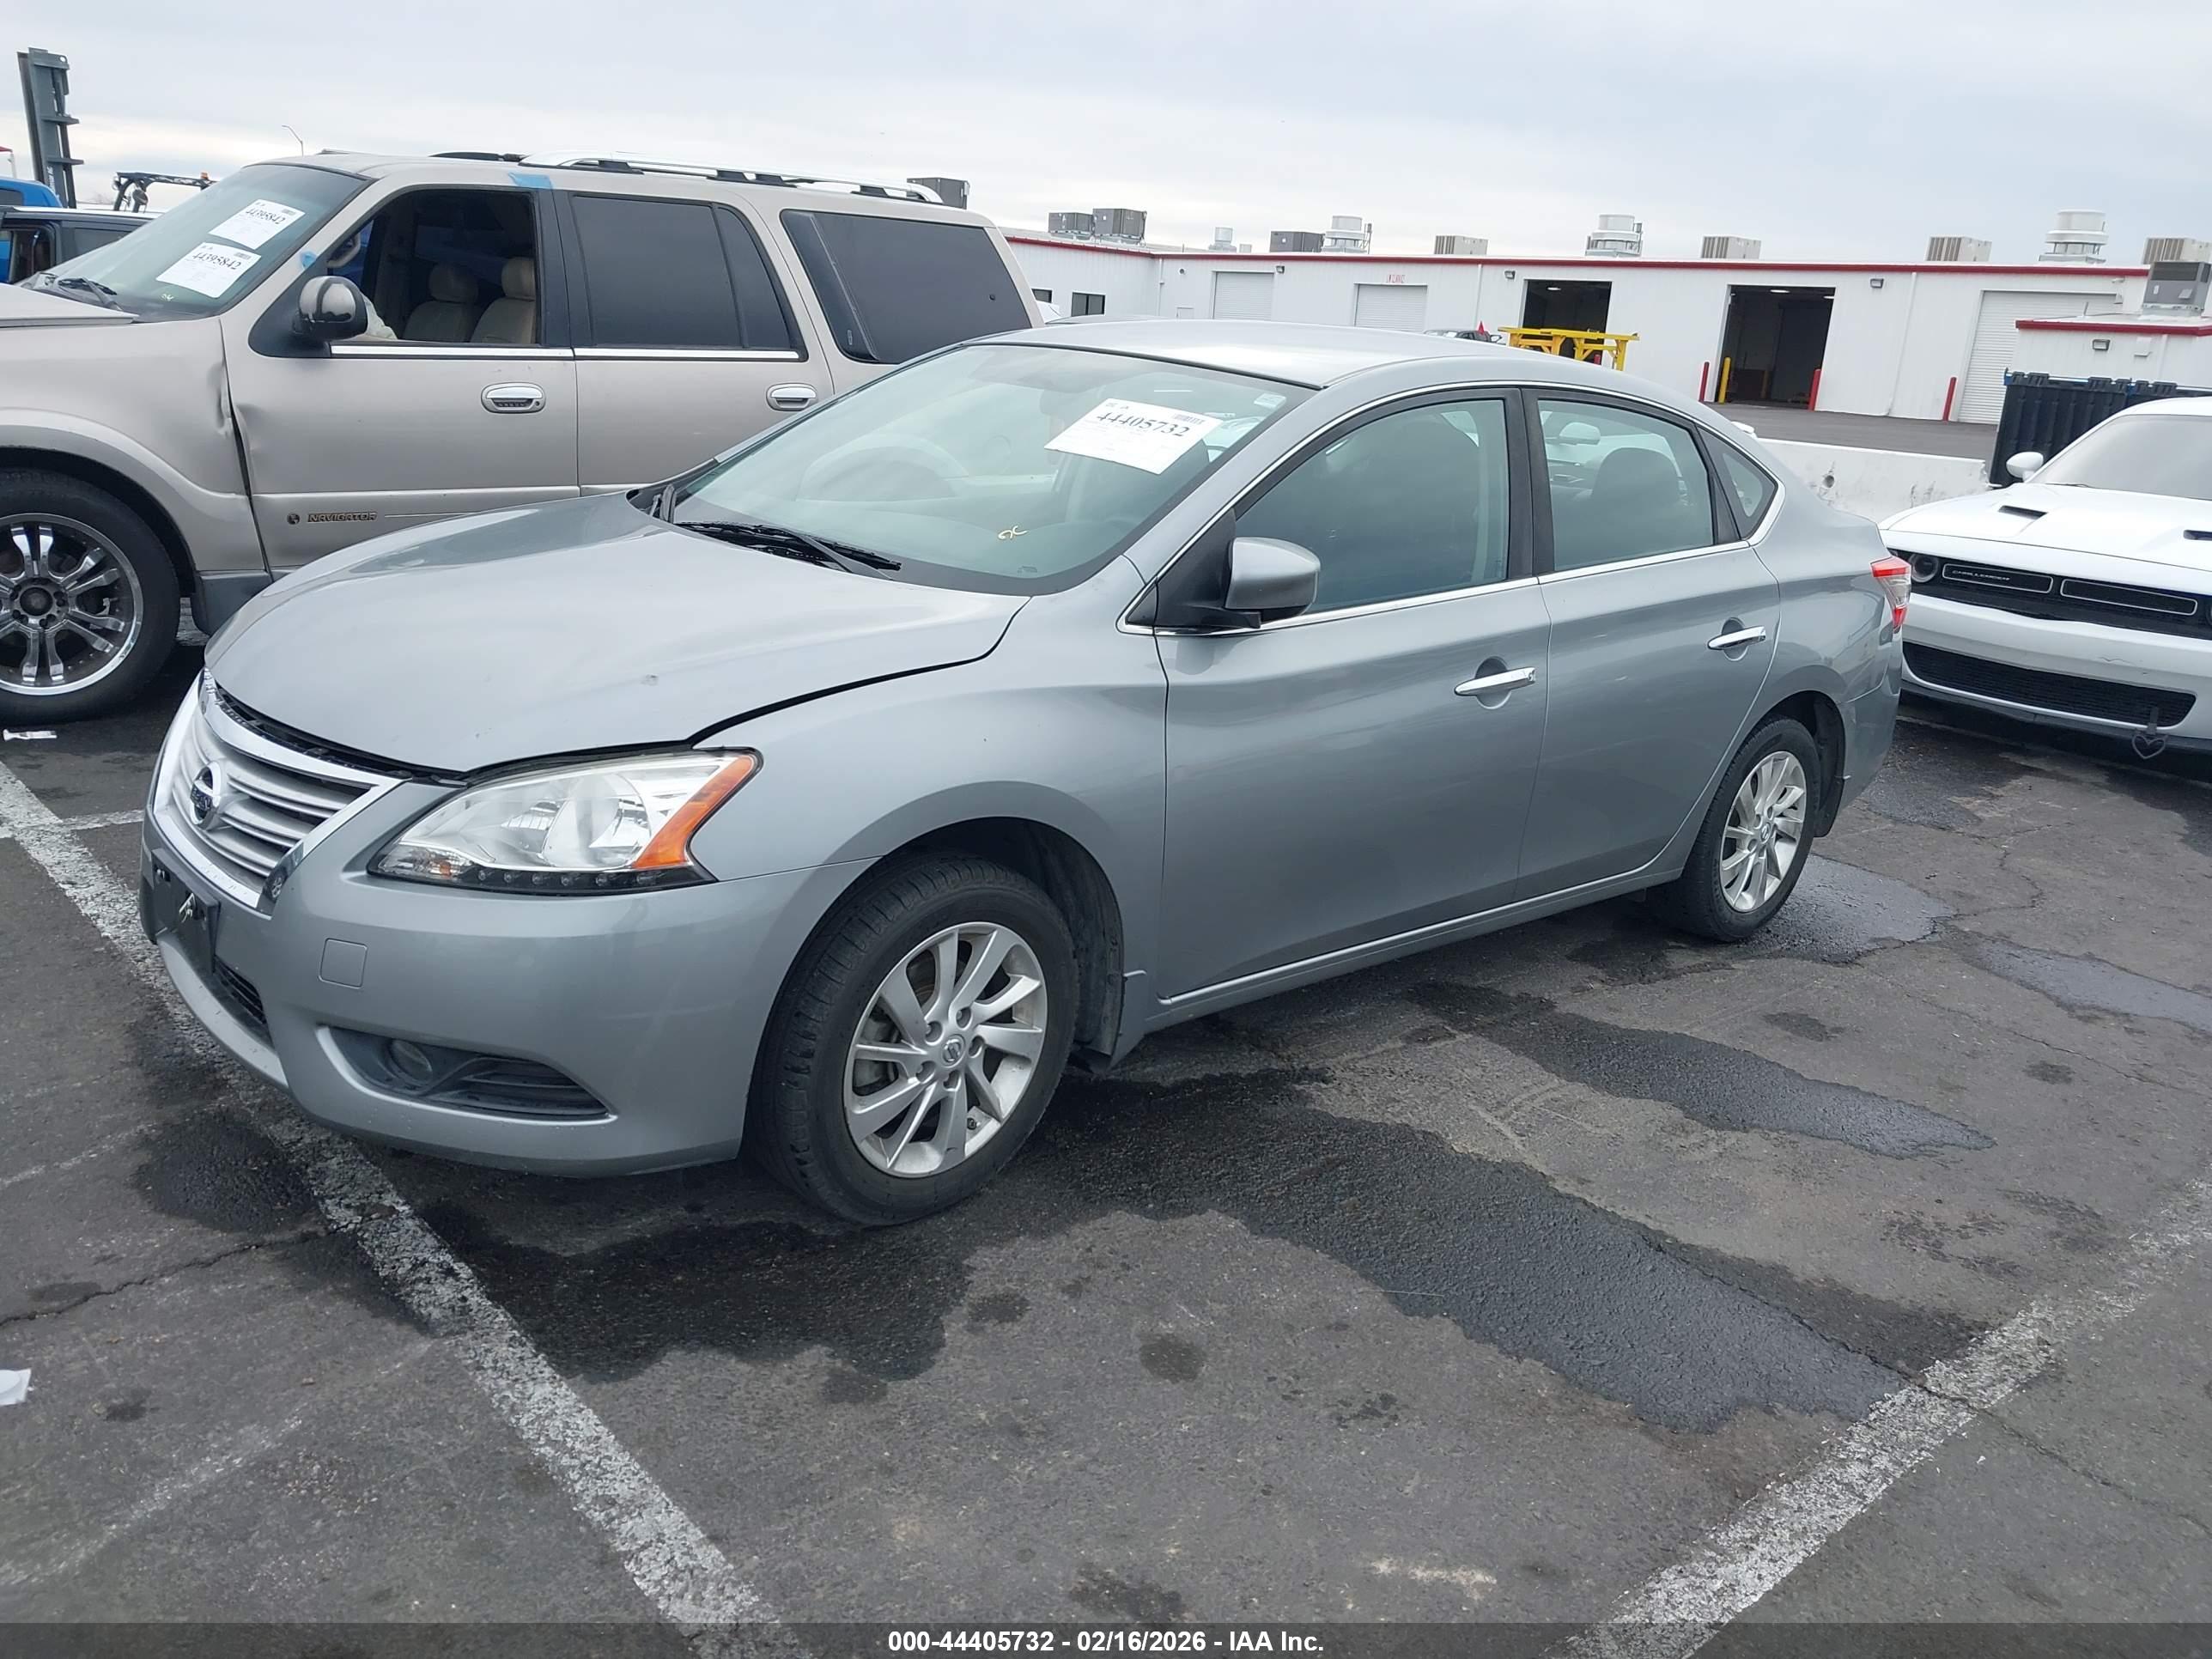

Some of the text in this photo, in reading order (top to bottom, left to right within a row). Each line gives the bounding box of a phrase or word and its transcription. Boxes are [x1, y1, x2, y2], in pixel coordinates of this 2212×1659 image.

[246, 208, 286, 224] 44395842
[192, 252, 241, 270] 44395842
[1097, 411, 1191, 437] 44405732
